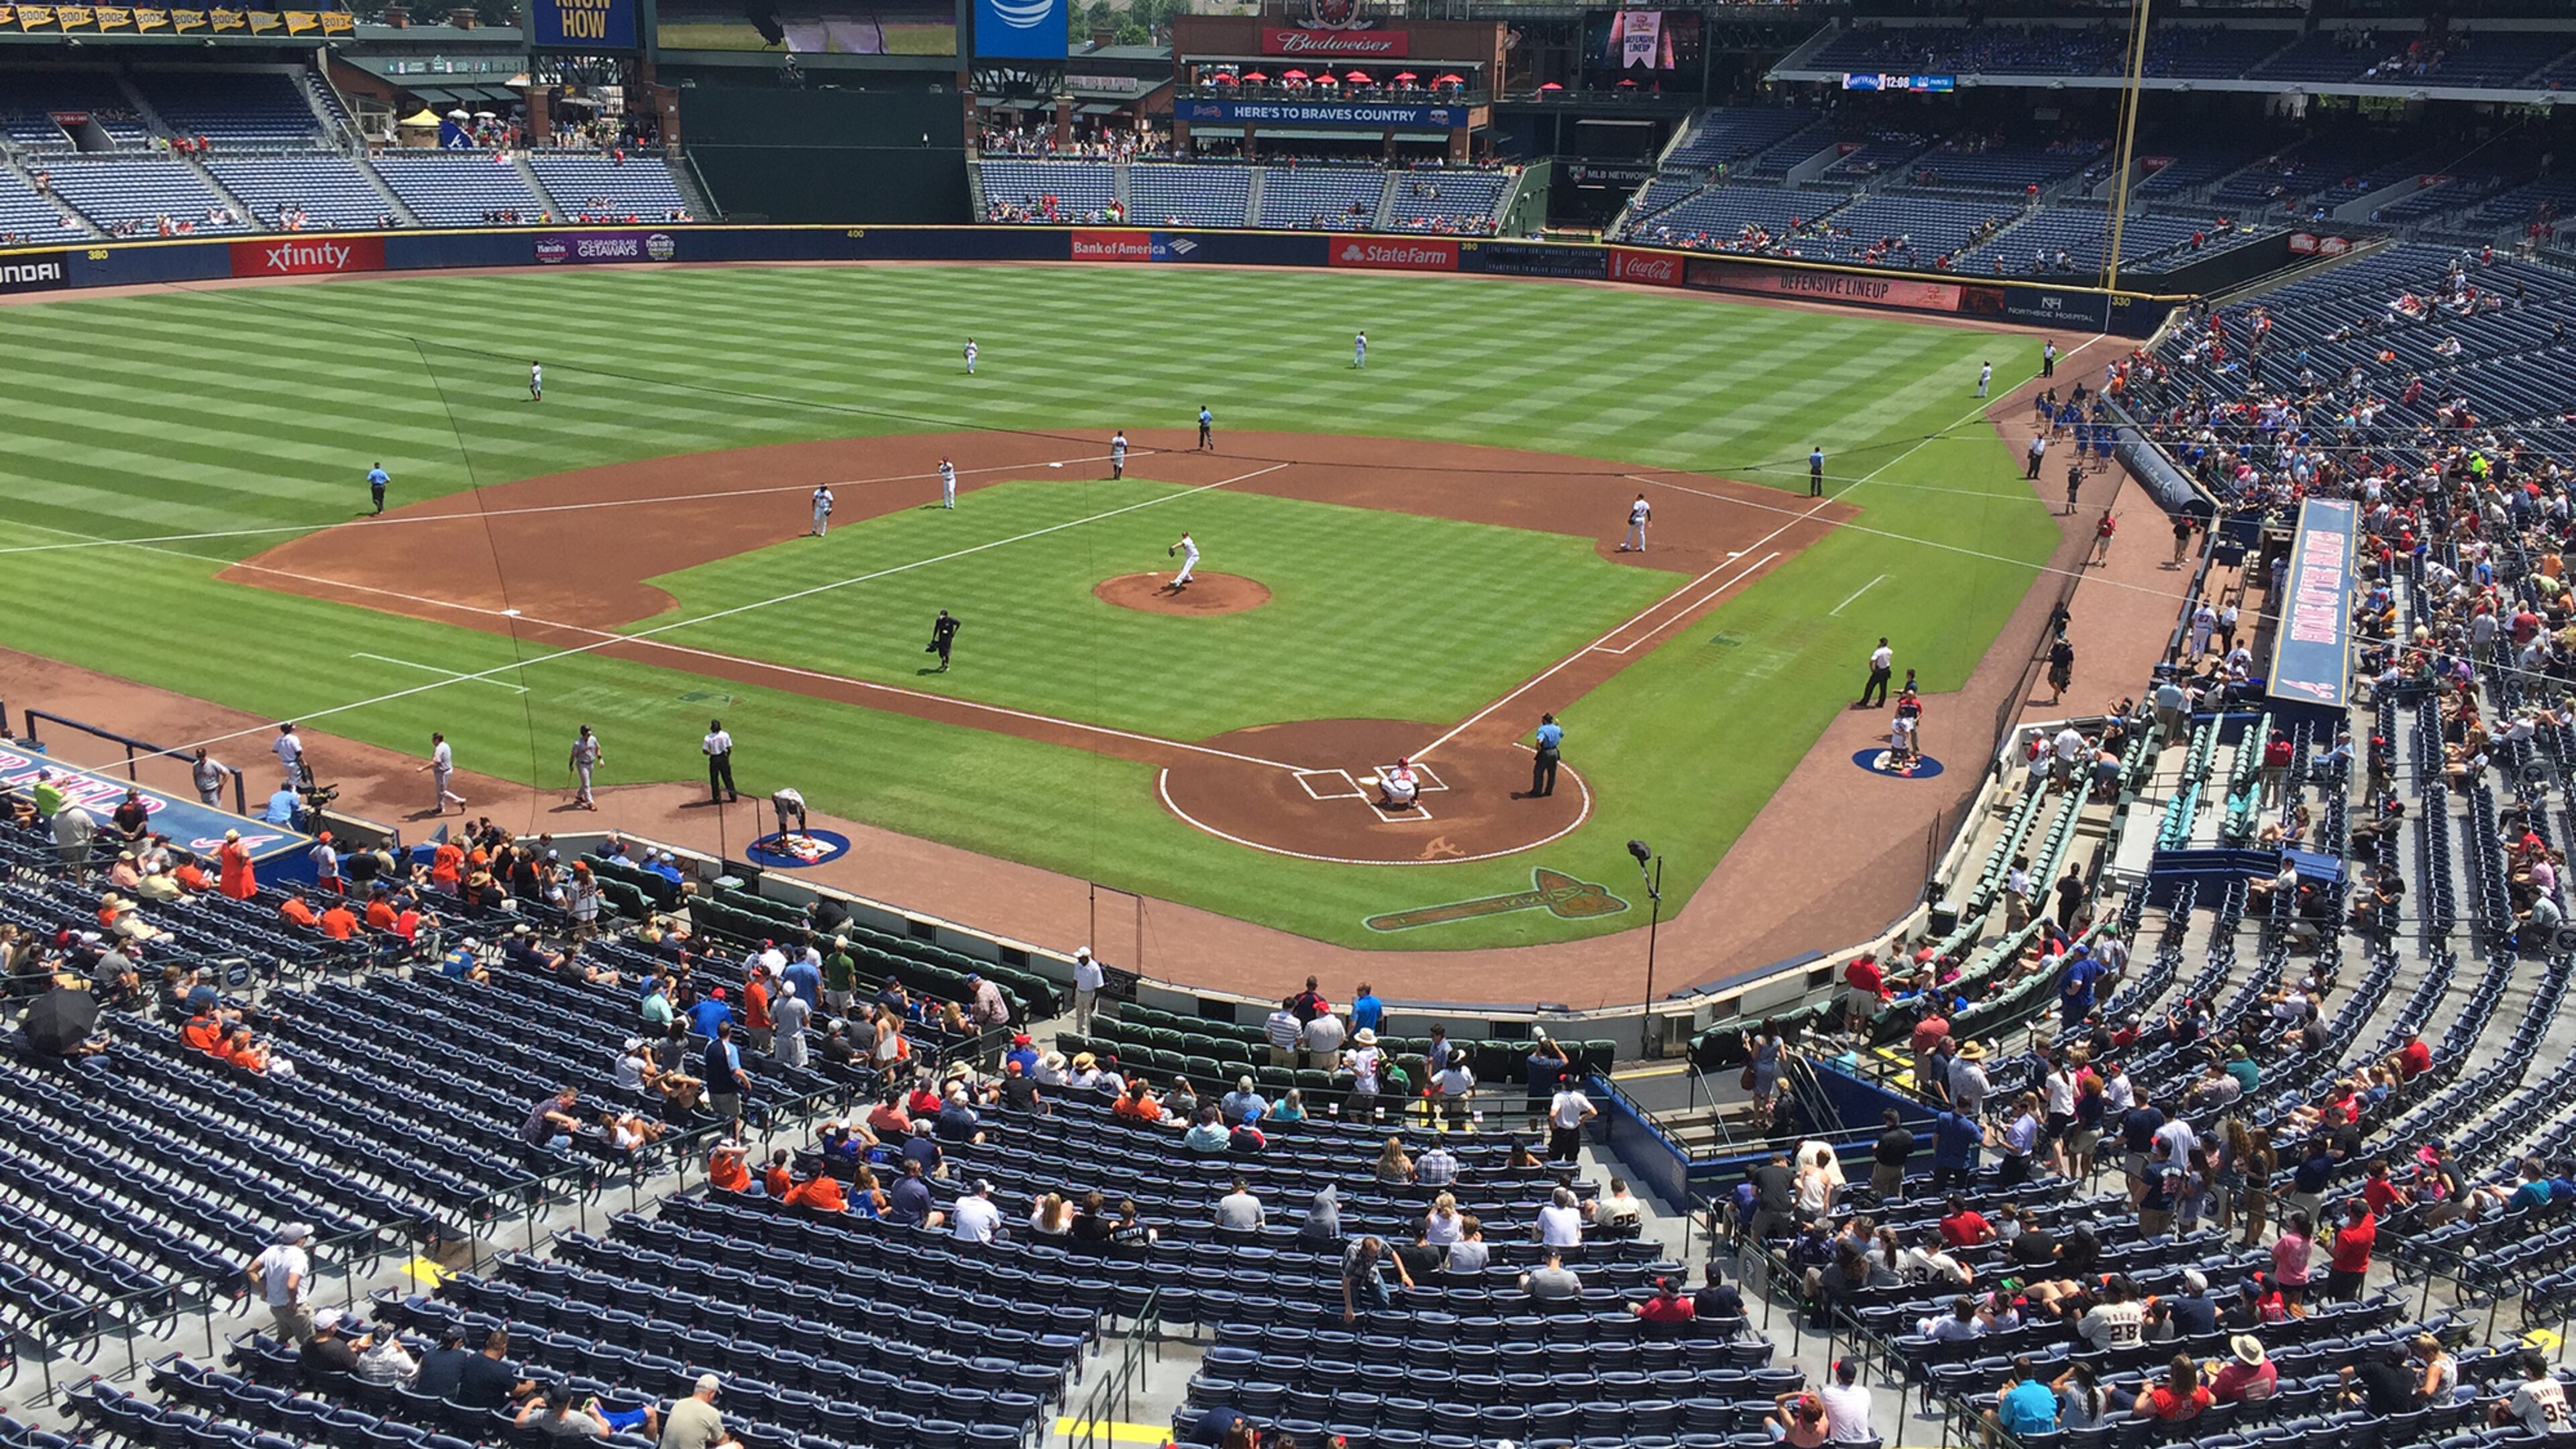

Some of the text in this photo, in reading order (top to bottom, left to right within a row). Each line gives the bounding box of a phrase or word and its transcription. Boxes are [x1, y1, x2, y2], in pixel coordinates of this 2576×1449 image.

[21, 11, 46, 21] 2000
[61, 12, 85, 22] 2001
[100, 12, 123, 22] 2002
[174, 13, 199, 25] 2004
[212, 13, 236, 24] 2005
[324, 17, 346, 27] 2013
[561, 9, 605, 38] HOW
[1277, 33, 1393, 51] Budweiser
[1886, 76, 1911, 88] 12:08
[1235, 106, 1279, 118] HERE'S
[1281, 107, 1299, 119] TO
[1301, 108, 1352, 120] BRAVES
[1354, 109, 1417, 122] COUNTRY
[1587, 170, 1607, 178] MLB
[578, 246, 638, 257] GETAWAYS
[1073, 242, 1166, 255] Bank of America
[1461, 243, 1478, 251] 390
[88, 250, 109, 260] 380
[266, 242, 351, 271] xfinity
[0, 262, 60, 284] NDAI
[1780, 274, 1889, 300] DEFENSIVE LINEUP
[2112, 297, 2131, 307] 330
[1914, 1266, 1944, 1281] 34
[2110, 1324, 2137, 1342] 28
[2542, 1401, 2569, 1422] 35
